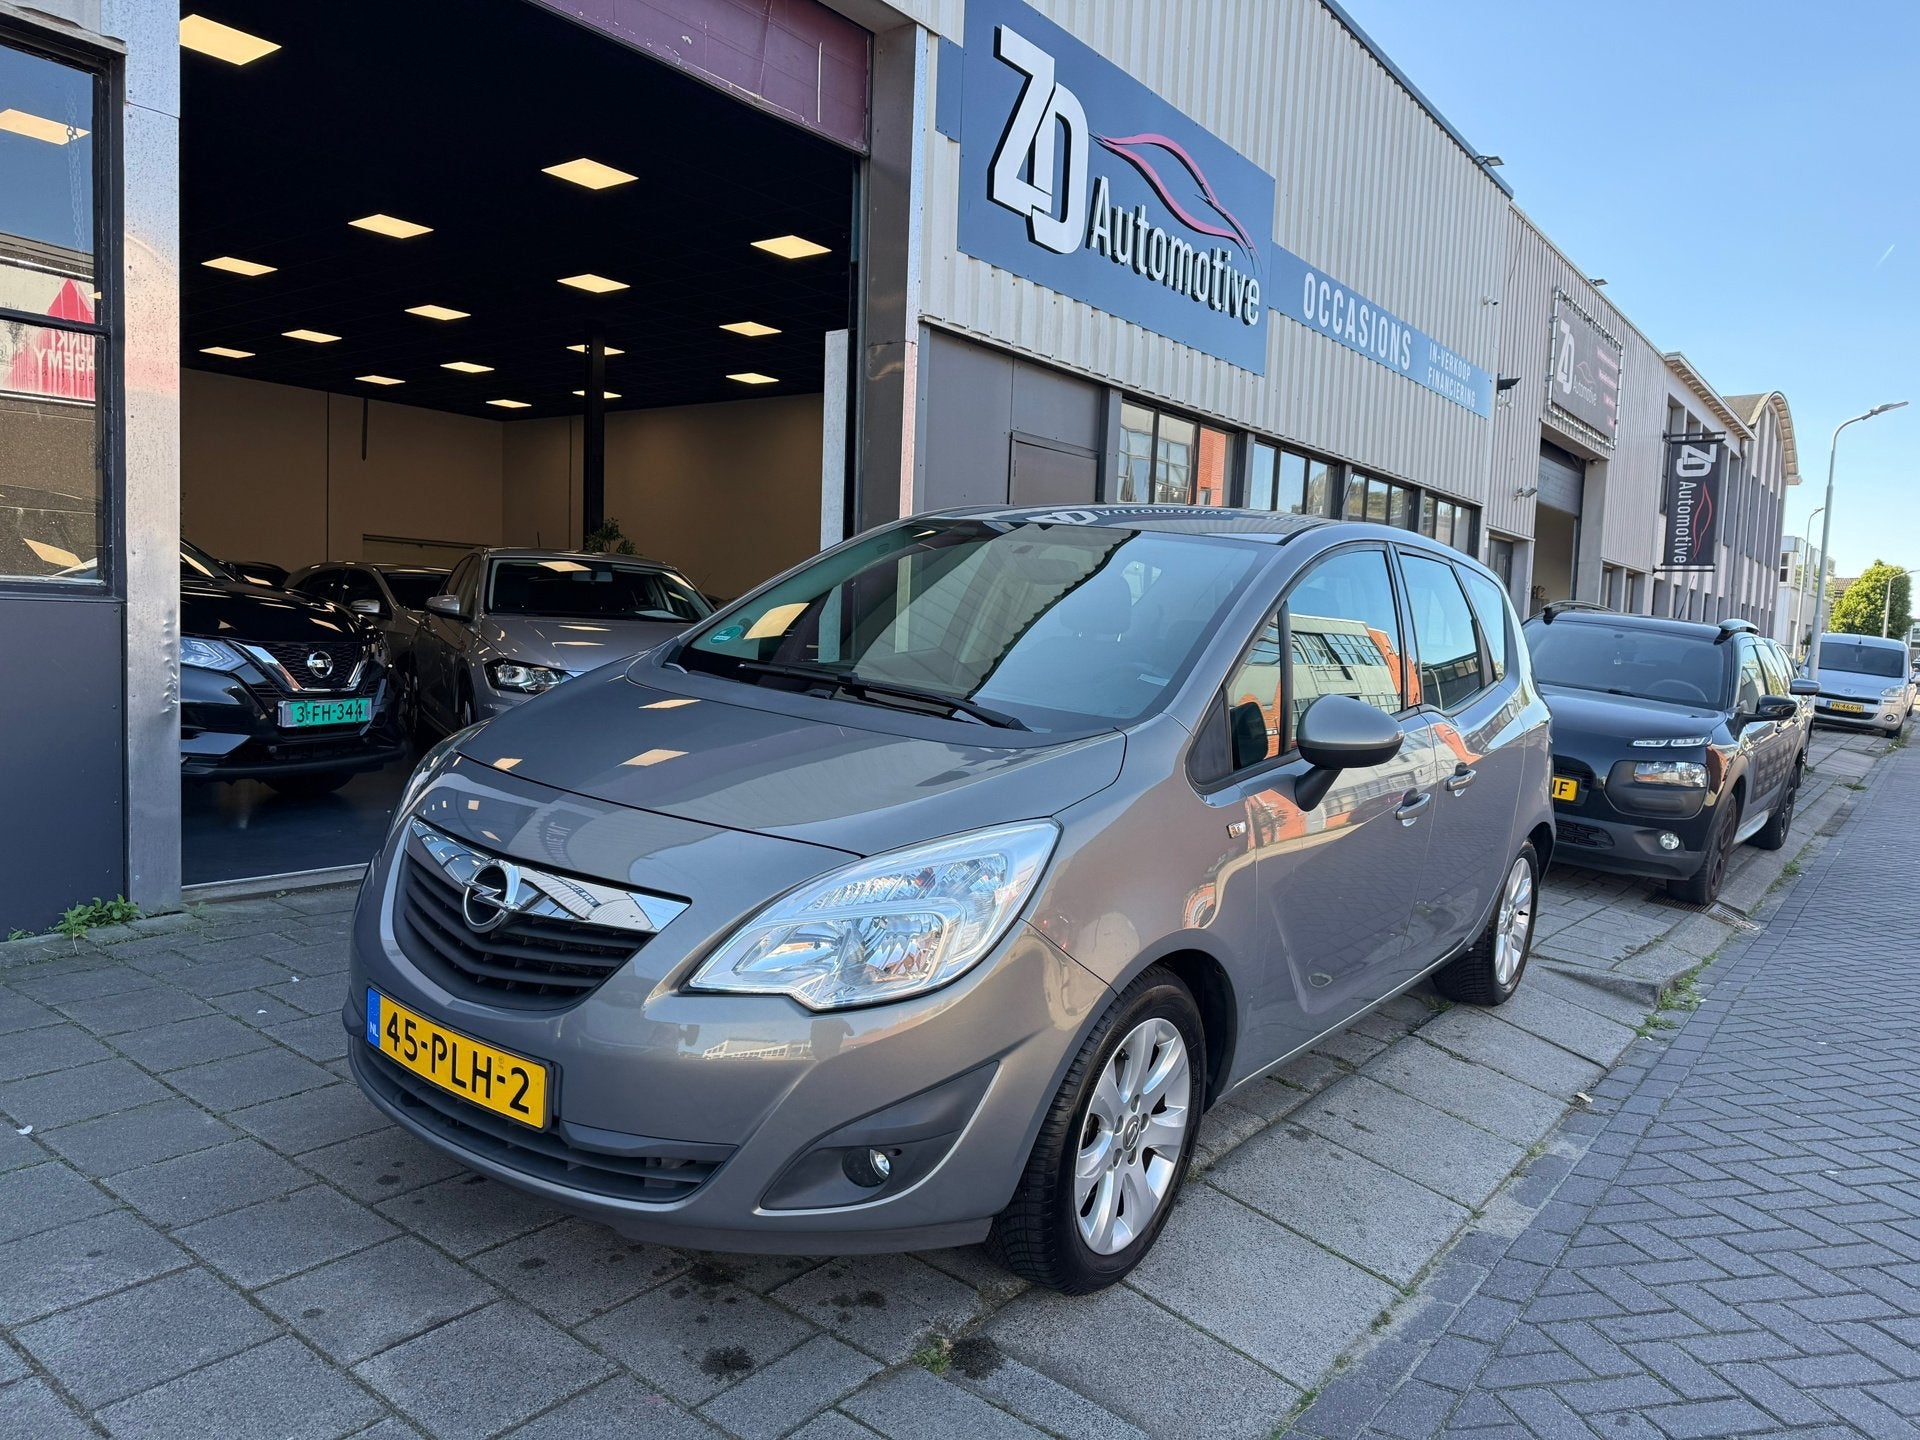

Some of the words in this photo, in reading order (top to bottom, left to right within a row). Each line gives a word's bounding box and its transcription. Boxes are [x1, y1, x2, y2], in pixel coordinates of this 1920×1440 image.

[1091, 175, 1261, 326] Automotive
[1303, 272, 1412, 371] OCCASIONS
[1427, 366, 1477, 409] FINANCIERING
[1429, 341, 1472, 383] IN-VERKOOP
[1673, 481, 1698, 564] Automotive
[296, 702, 363, 723] 3-FH-344
[369, 1021, 379, 1038] NL
[386, 1011, 530, 1115] 45-PLH-2
